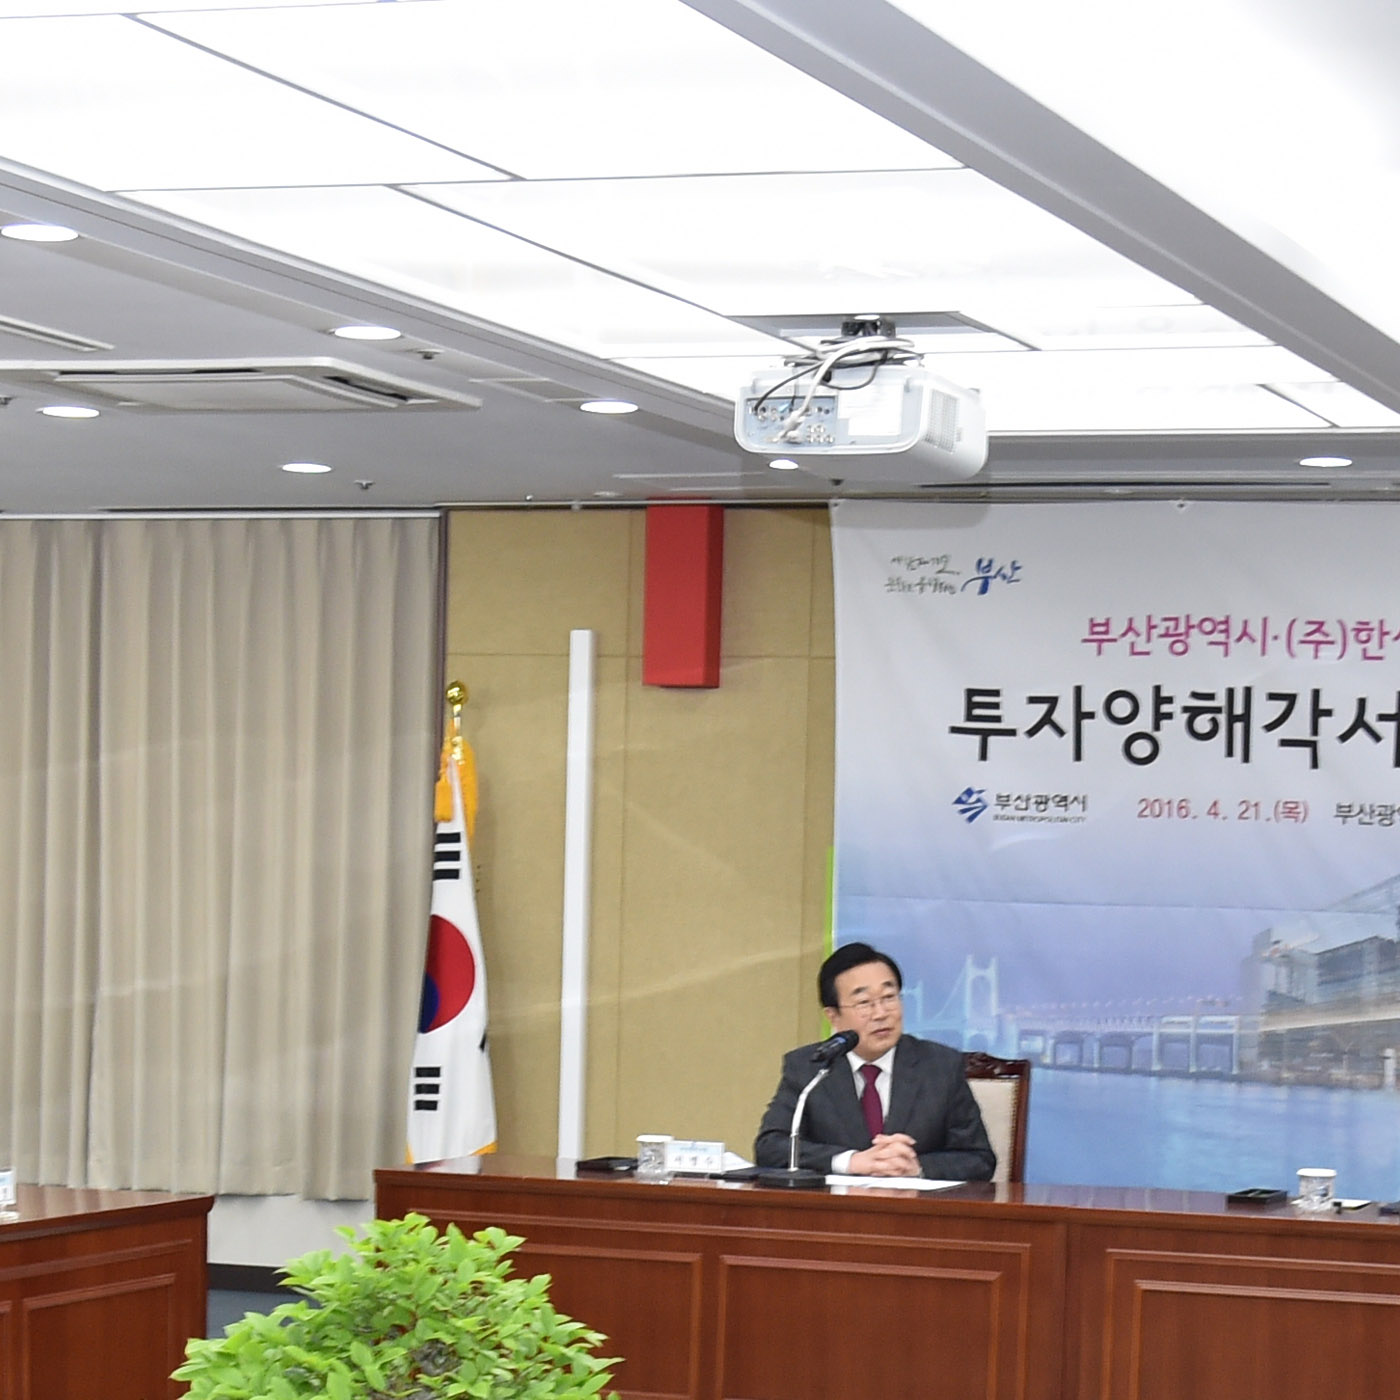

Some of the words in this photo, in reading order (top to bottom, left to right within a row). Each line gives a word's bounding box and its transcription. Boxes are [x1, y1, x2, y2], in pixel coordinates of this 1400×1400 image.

[960, 557, 1023, 596] 부산
[994, 793, 1089, 813] 부산광역시
[1136, 797, 1199, 820] 2016.
[1205, 799, 1228, 821] 4.
